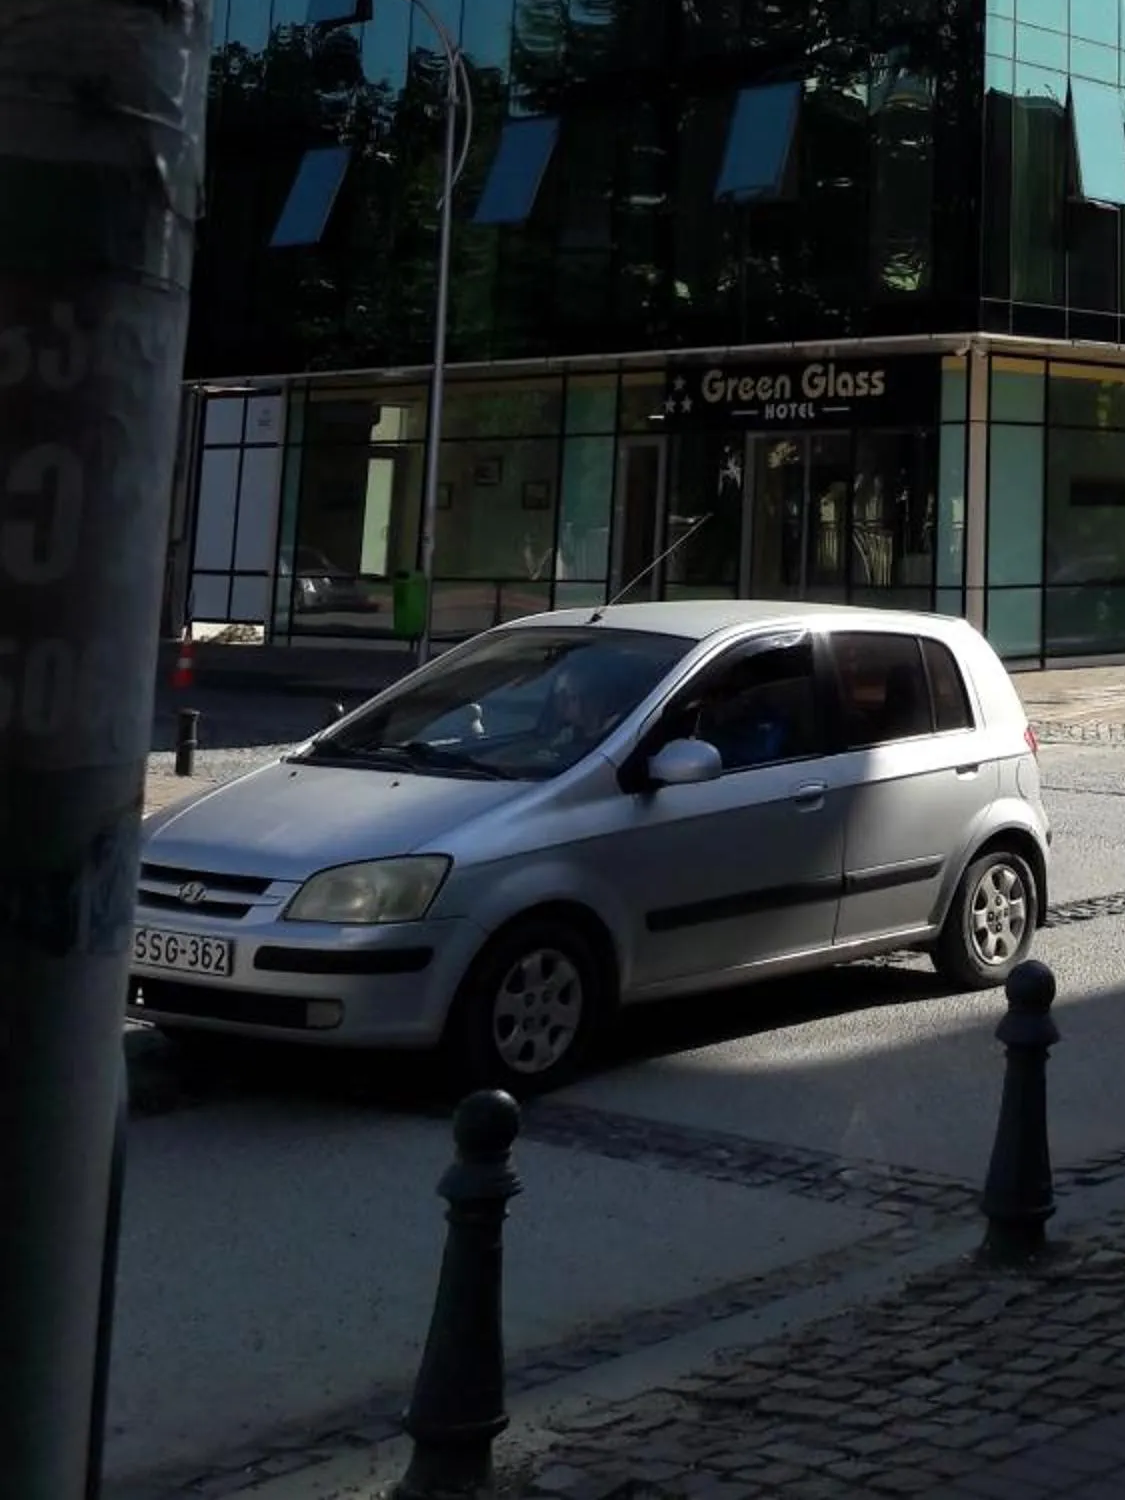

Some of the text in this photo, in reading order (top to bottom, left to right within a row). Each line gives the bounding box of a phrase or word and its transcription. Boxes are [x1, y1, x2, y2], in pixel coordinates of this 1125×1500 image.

[701, 363, 886, 403] Green Glass
[764, 403, 816, 420] HOTEL
[135, 930, 225, 971] SSG-362
